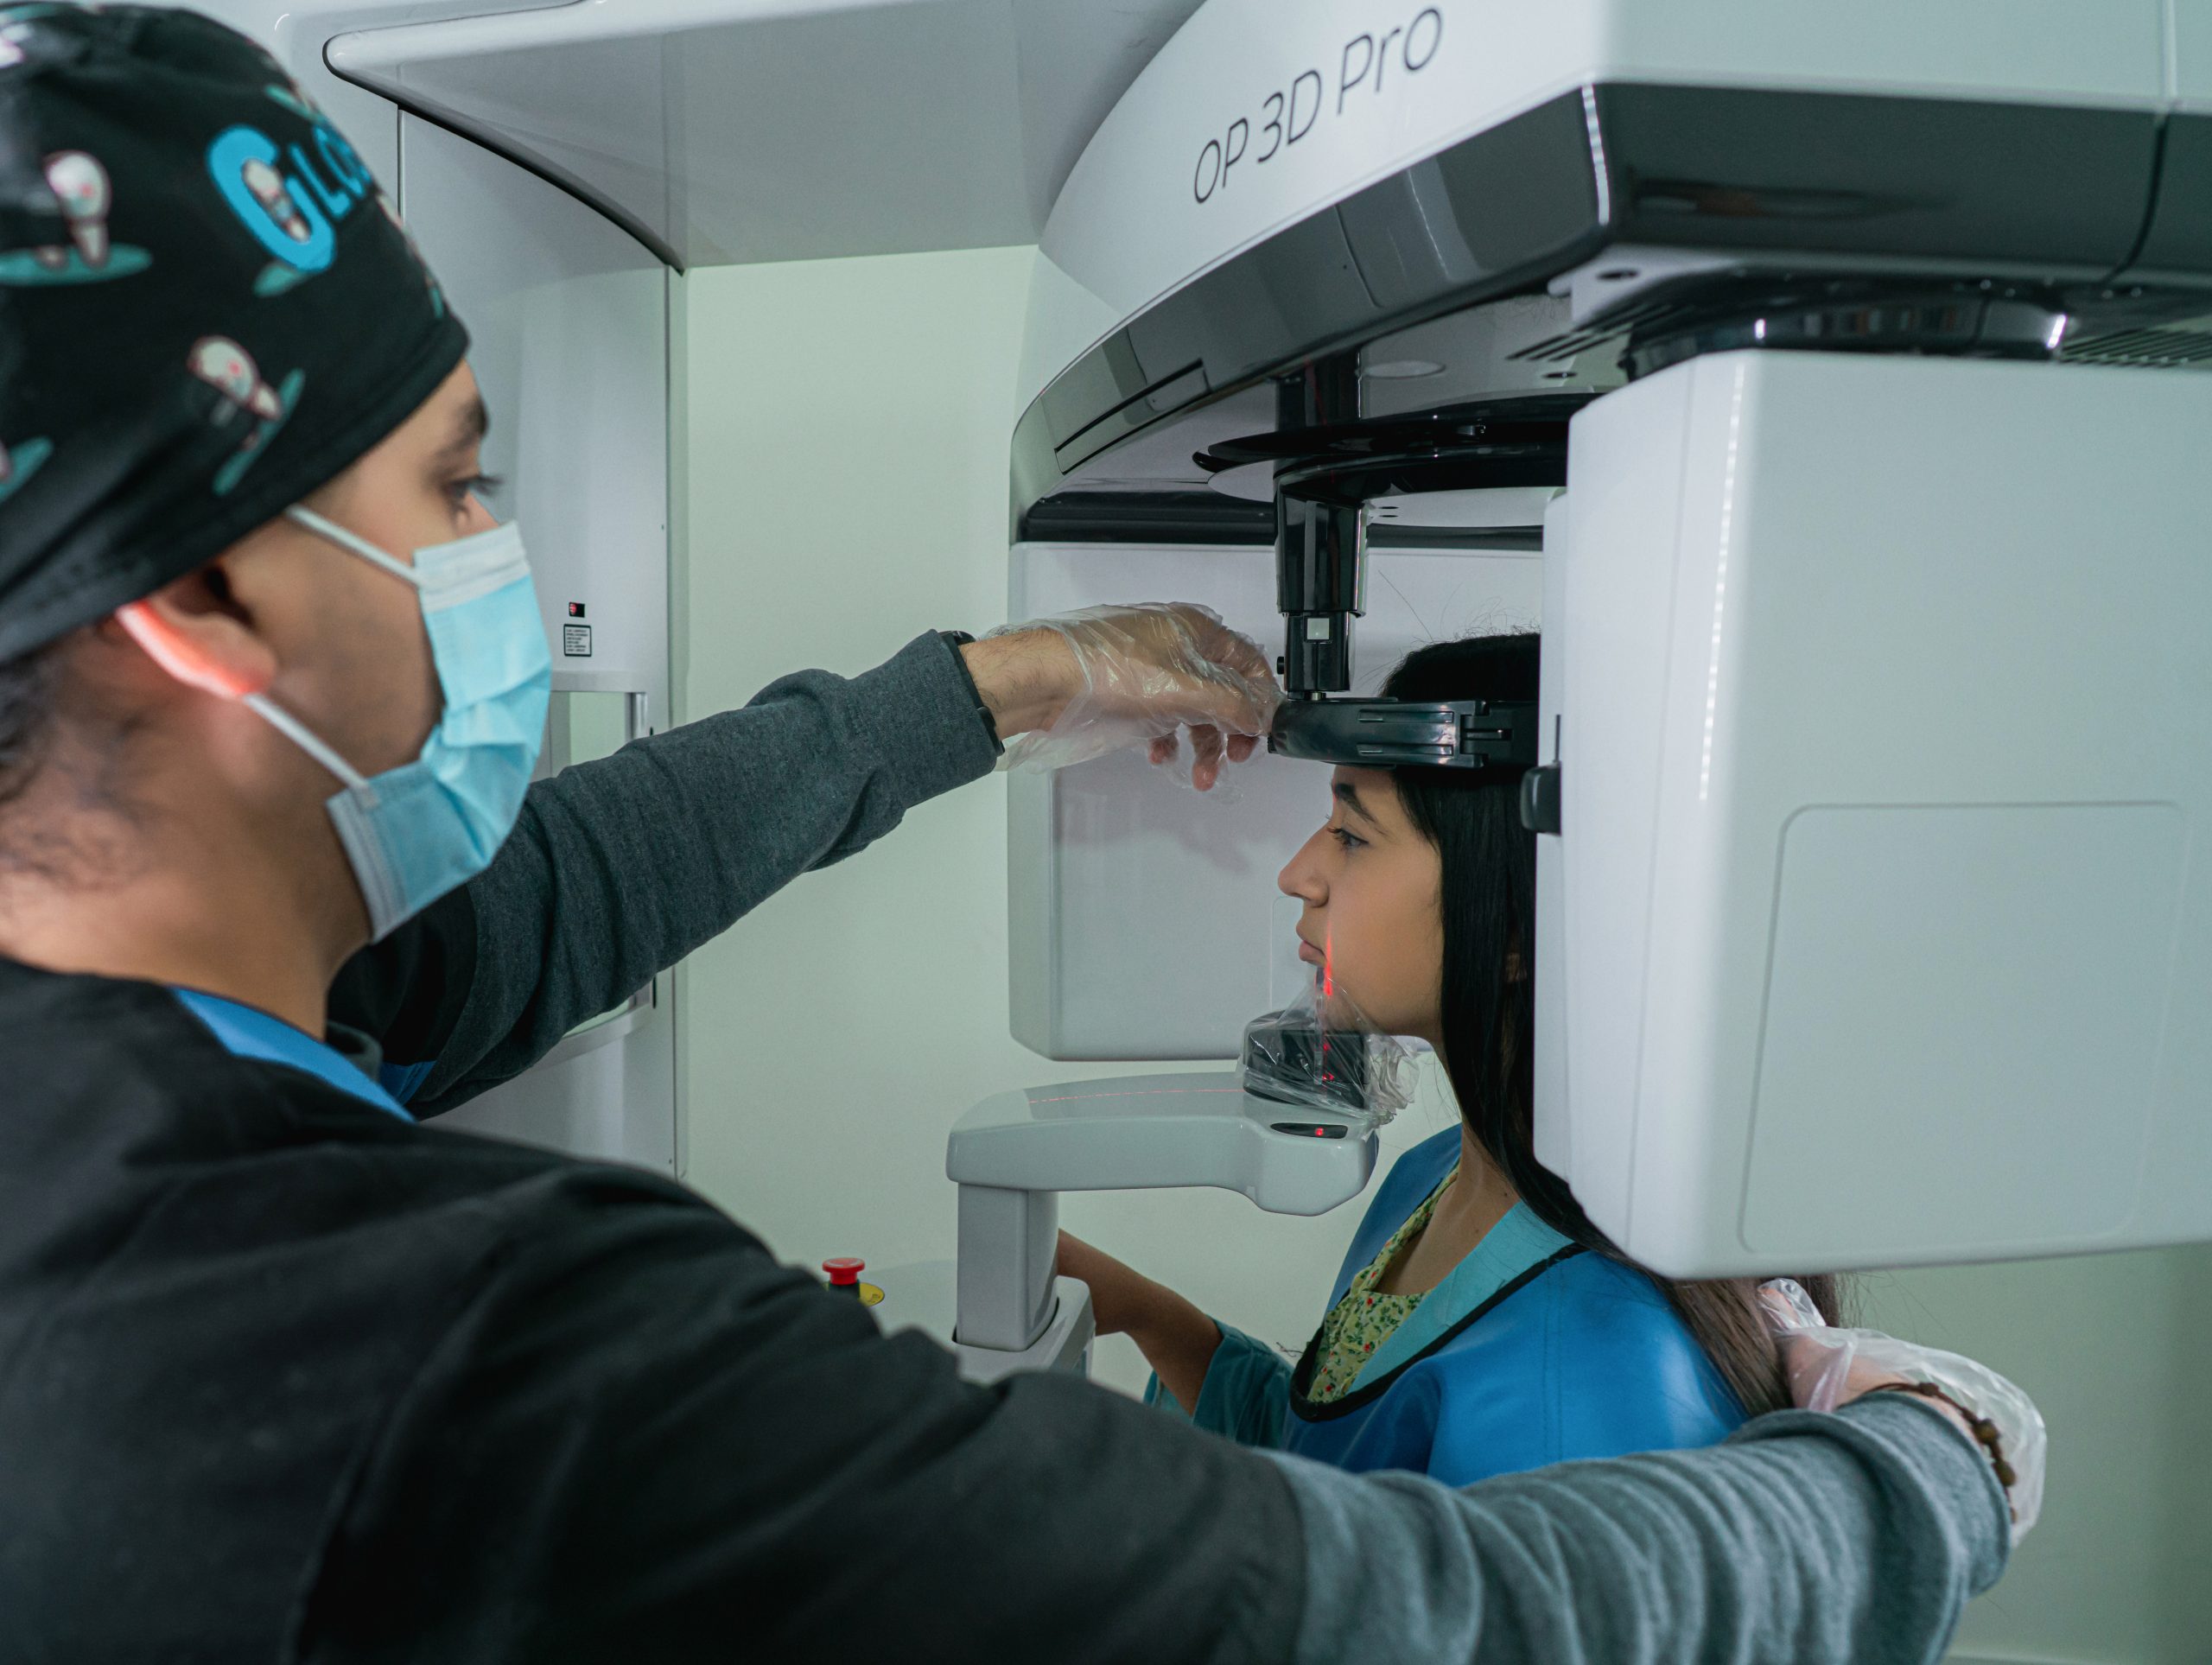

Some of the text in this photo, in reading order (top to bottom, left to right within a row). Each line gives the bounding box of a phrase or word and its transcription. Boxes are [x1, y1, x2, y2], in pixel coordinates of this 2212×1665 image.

[1194, 8, 1442, 204] OP 3D Pro
